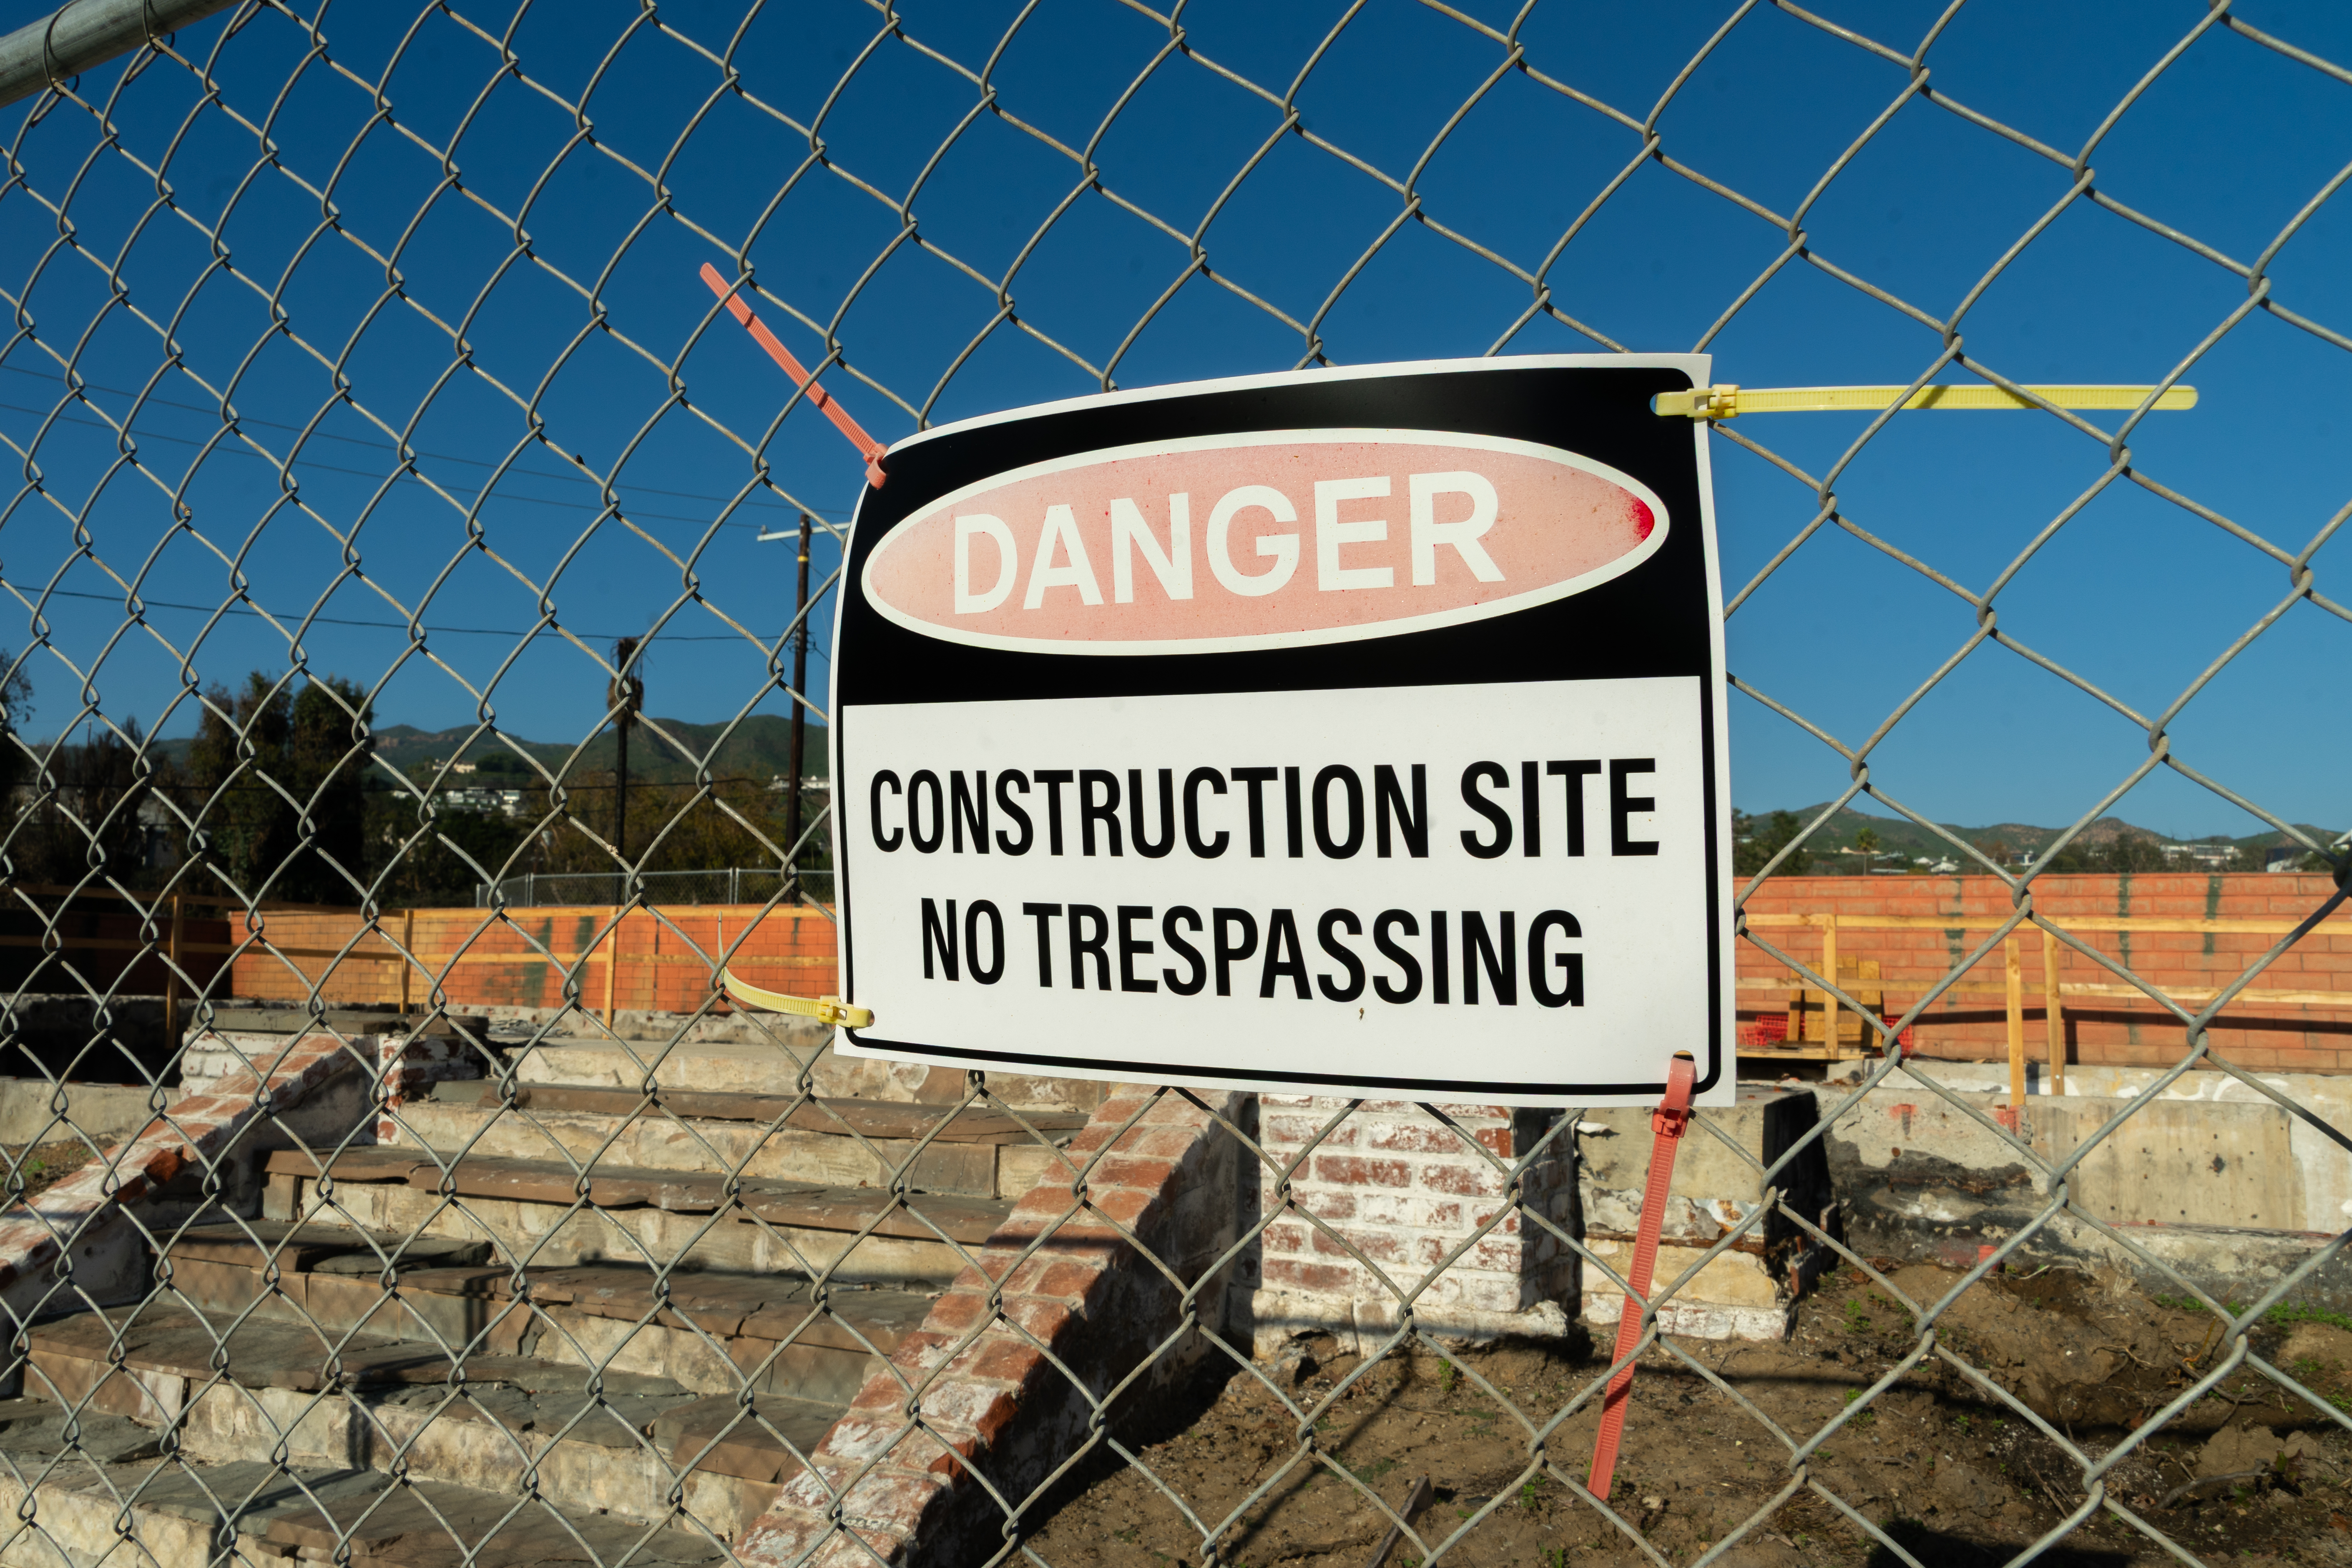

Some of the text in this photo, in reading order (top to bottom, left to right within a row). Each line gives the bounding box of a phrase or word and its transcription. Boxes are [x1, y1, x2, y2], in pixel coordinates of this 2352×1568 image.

[954, 472, 1505, 615] DANGER
[870, 758, 1659, 859] CONSTRUCTION SITE
[921, 897, 1584, 1008] NO TRESPASSING
